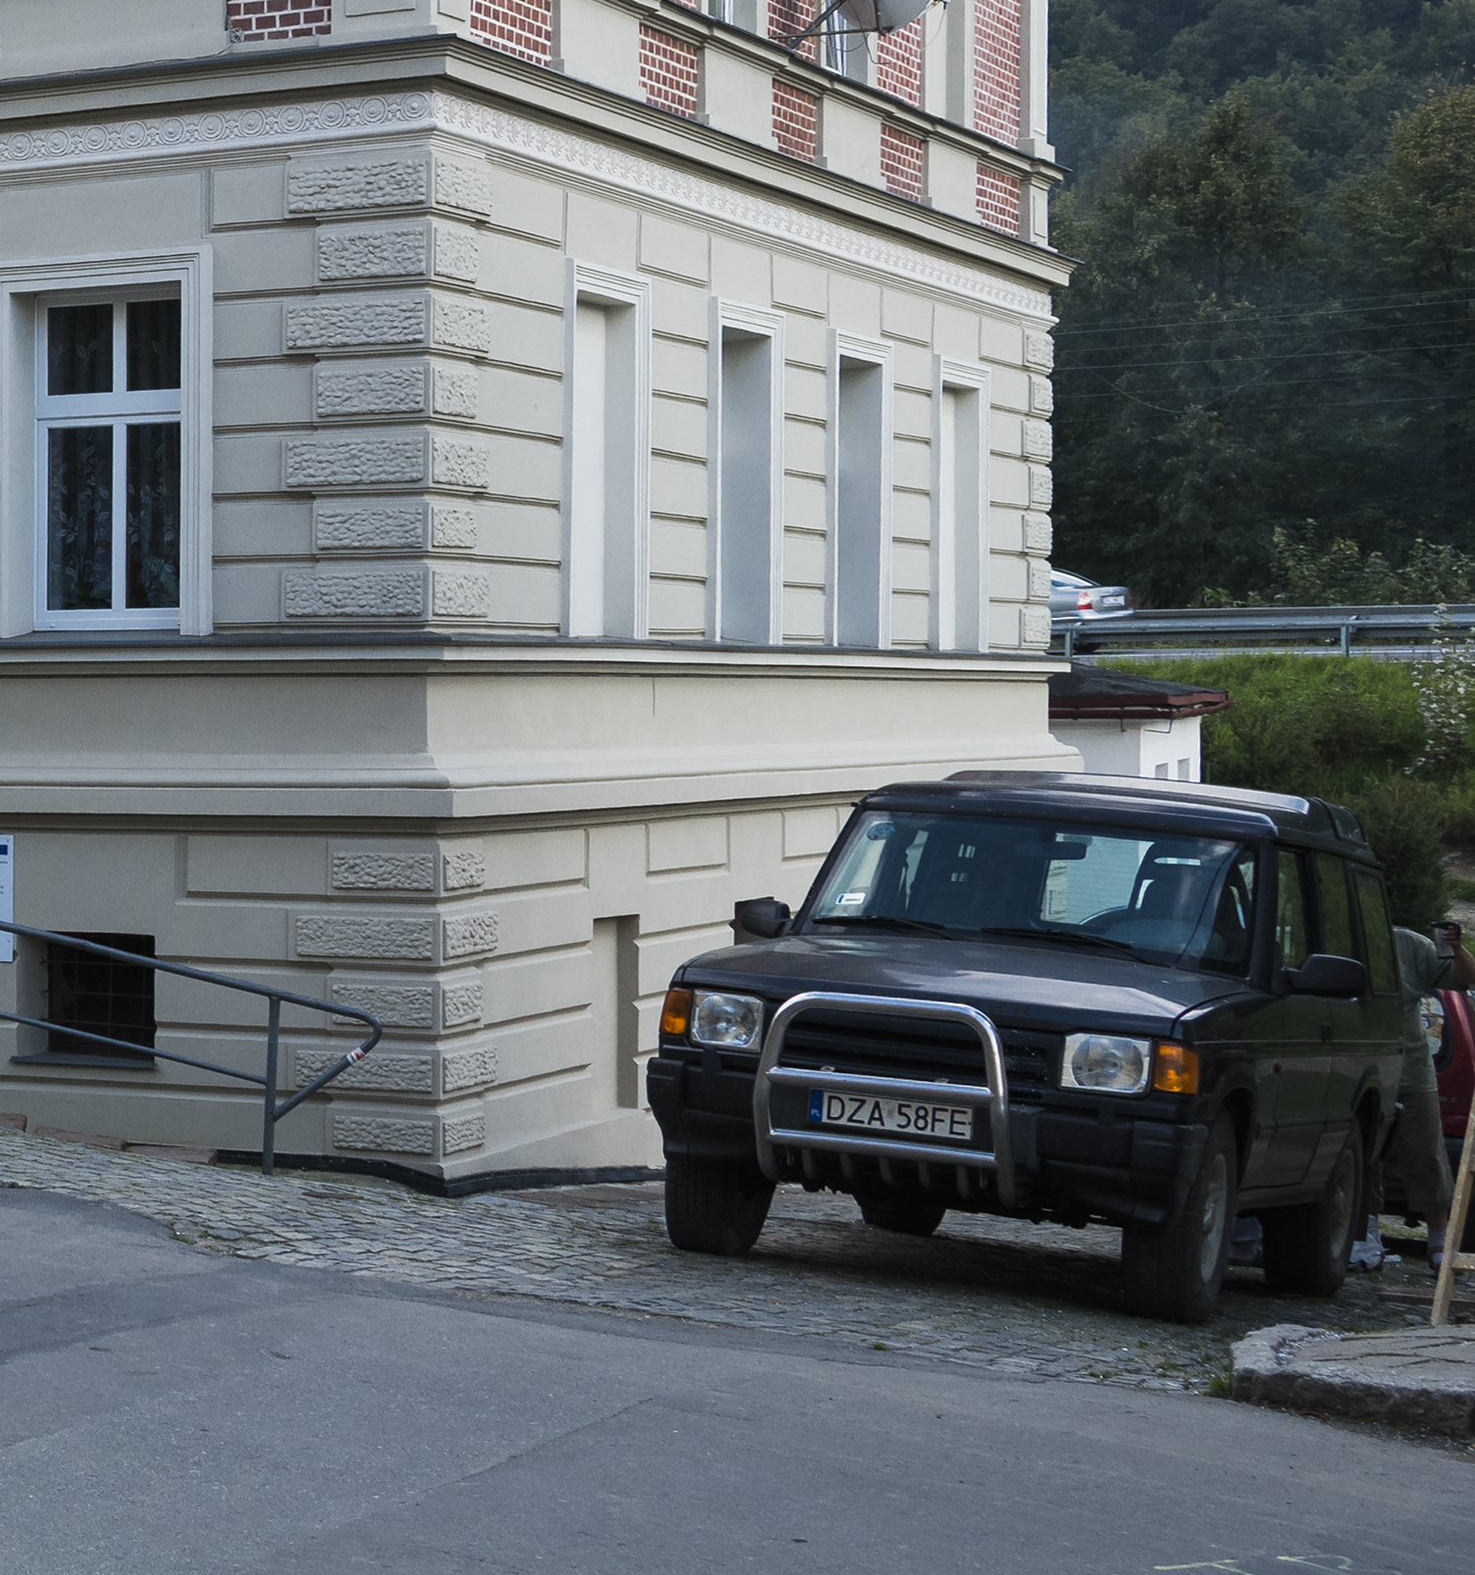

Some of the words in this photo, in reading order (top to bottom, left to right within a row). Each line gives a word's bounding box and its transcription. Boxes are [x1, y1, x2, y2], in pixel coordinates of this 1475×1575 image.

[810, 1109, 821, 1117] PL
[826, 1095, 886, 1127] DZA
[896, 1103, 968, 1136] 58FE
